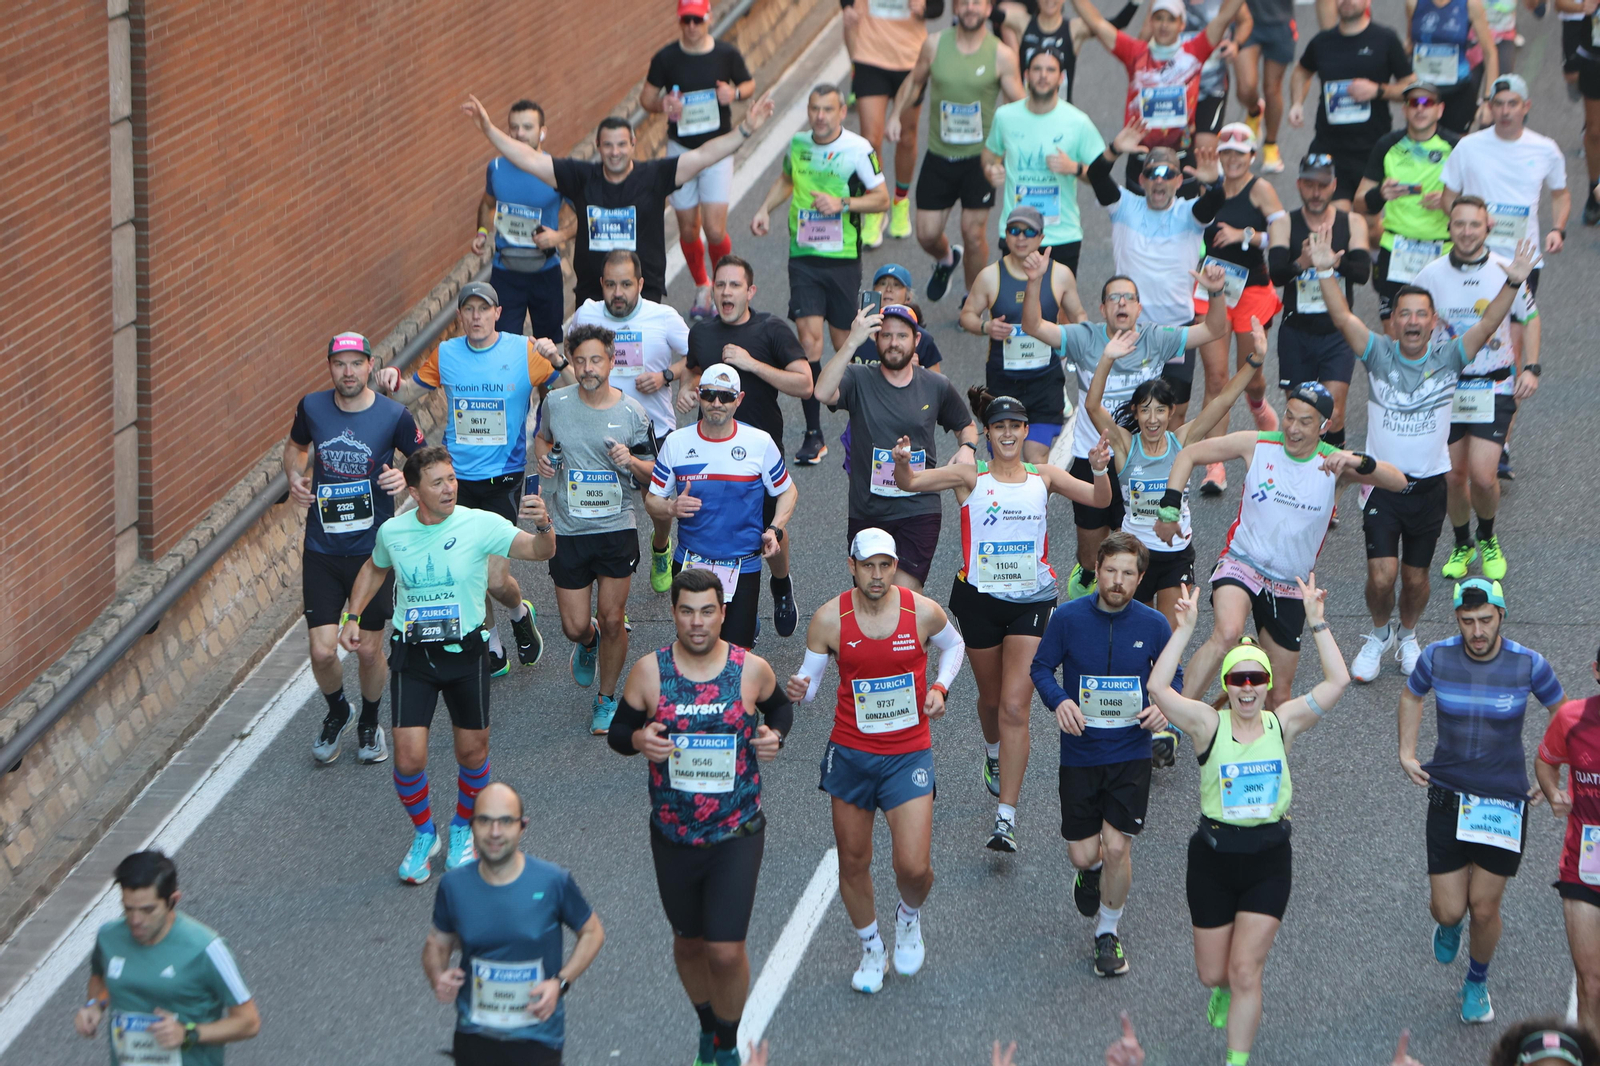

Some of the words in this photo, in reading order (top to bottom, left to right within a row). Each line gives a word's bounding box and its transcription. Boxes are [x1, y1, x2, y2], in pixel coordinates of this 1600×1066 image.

[510, 208, 535, 217] ZURICH
[602, 223, 620, 231] 11434
[614, 333, 636, 342] URICH
[455, 384, 479, 392] Konin
[482, 384, 504, 392] RUN
[1382, 420, 1437, 433] RUNNERS
[320, 450, 368, 464] SWISS
[586, 472, 613, 481] ZURICH
[334, 484, 364, 496] ZURICH
[1275, 490, 1296, 501] Naeva
[336, 502, 355, 511] 2325
[1273, 497, 1300, 509] running
[340, 513, 355, 521] STEF
[407, 591, 455, 603] SEVILLA'24
[421, 608, 452, 618] ZURICH
[422, 626, 441, 636] 2379
[874, 678, 906, 690] ZURICH
[876, 699, 895, 708] 9737
[675, 703, 727, 715] SAYSKY
[865, 708, 910, 720] GONZALO/ANA
[692, 739, 727, 747] ZURICH
[692, 758, 712, 766] 9546
[1243, 764, 1277, 775] ZURICH
[675, 770, 694, 778] TIAGO
[696, 770, 730, 780] PREGUIÇA
[1243, 784, 1264, 792] 3806
[1484, 798, 1515, 810] ZURICH
[1493, 827, 1512, 837] SILVA
